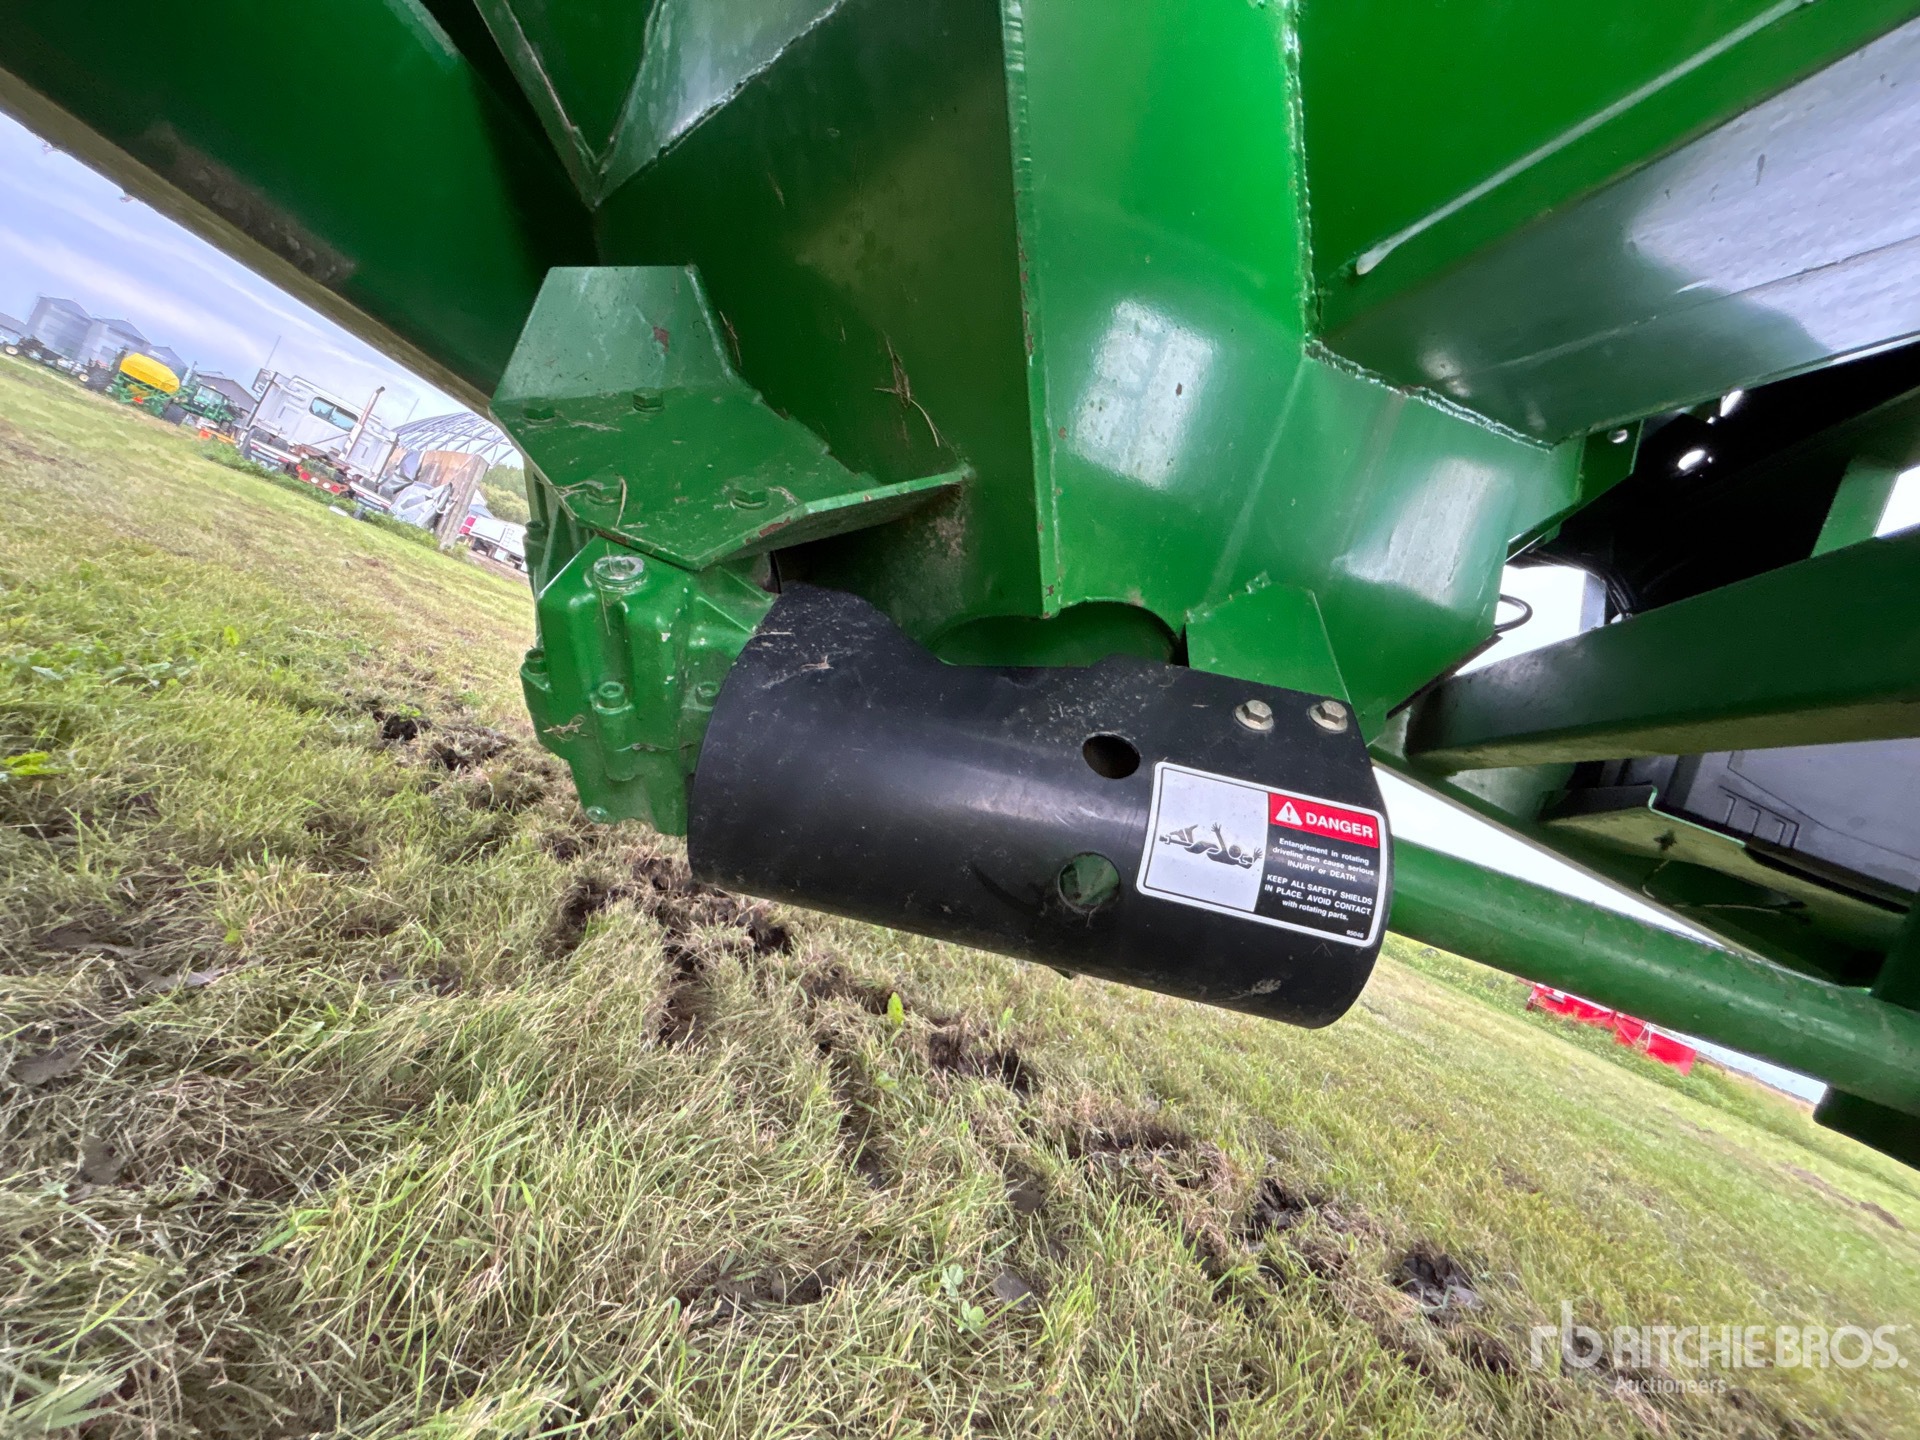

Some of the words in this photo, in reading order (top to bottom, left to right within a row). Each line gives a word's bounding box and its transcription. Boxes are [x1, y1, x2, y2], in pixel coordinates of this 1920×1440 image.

[1306, 812, 1373, 838] DANGER
[1272, 846, 1304, 859] driveline
[1306, 855, 1320, 863] can
[1323, 859, 1344, 869] cause
[1348, 864, 1374, 876] serious
[1279, 838, 1328, 856] Entanglement
[1342, 853, 1370, 866] rotating
[1288, 860, 1315, 872] INJURY
[1330, 870, 1358, 882] DEATH.
[1264, 884, 1273, 892] IN
[1276, 887, 1304, 900] PLACE.
[1306, 894, 1332, 906] AVOID
[1334, 901, 1372, 915] CONTACT
[1266, 874, 1288, 884] KEEP
[1290, 880, 1306, 890] ALL
[1307, 884, 1338, 896] SAFETY
[1340, 892, 1373, 906] SHIELDS
[1282, 899, 1298, 908] with
[1298, 904, 1328, 916] rotating
[1328, 911, 1349, 921] parts.
